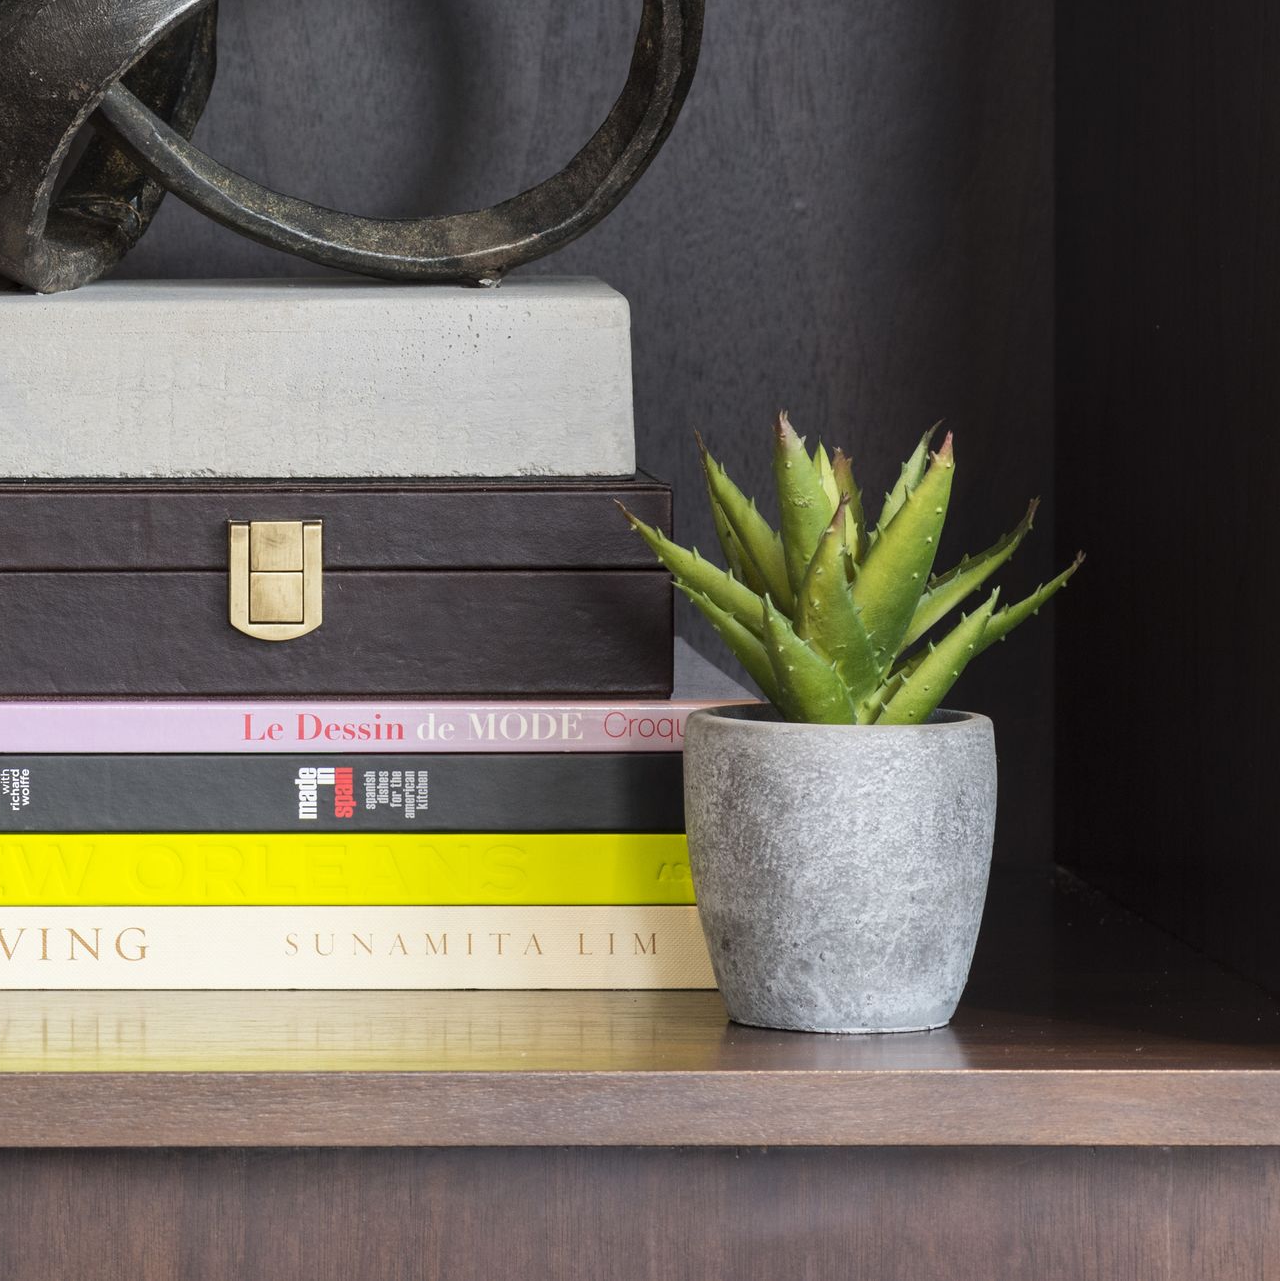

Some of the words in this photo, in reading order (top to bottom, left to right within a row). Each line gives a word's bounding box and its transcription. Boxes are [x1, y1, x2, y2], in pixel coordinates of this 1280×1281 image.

[242, 712, 284, 741] Le
[295, 712, 404, 741] Dessin
[416, 712, 455, 741] de
[466, 712, 584, 741] MODE
[0, 768, 10, 794] with
[10, 768, 20, 811] richard
[20, 768, 30, 806] wolffe
[294, 767, 317, 819] made
[317, 767, 335, 785] in
[335, 767, 357, 818] spain
[363, 770, 378, 810] spanish
[377, 770, 389, 804] dishes
[390, 770, 402, 789] the
[403, 770, 415, 819] american
[416, 770, 428, 810] kitchen
[390, 790, 402, 808] for
[129, 841, 530, 898] ORLEANS
[283, 931, 545, 957] SUNAMITA
[578, 932, 658, 957] LIM
